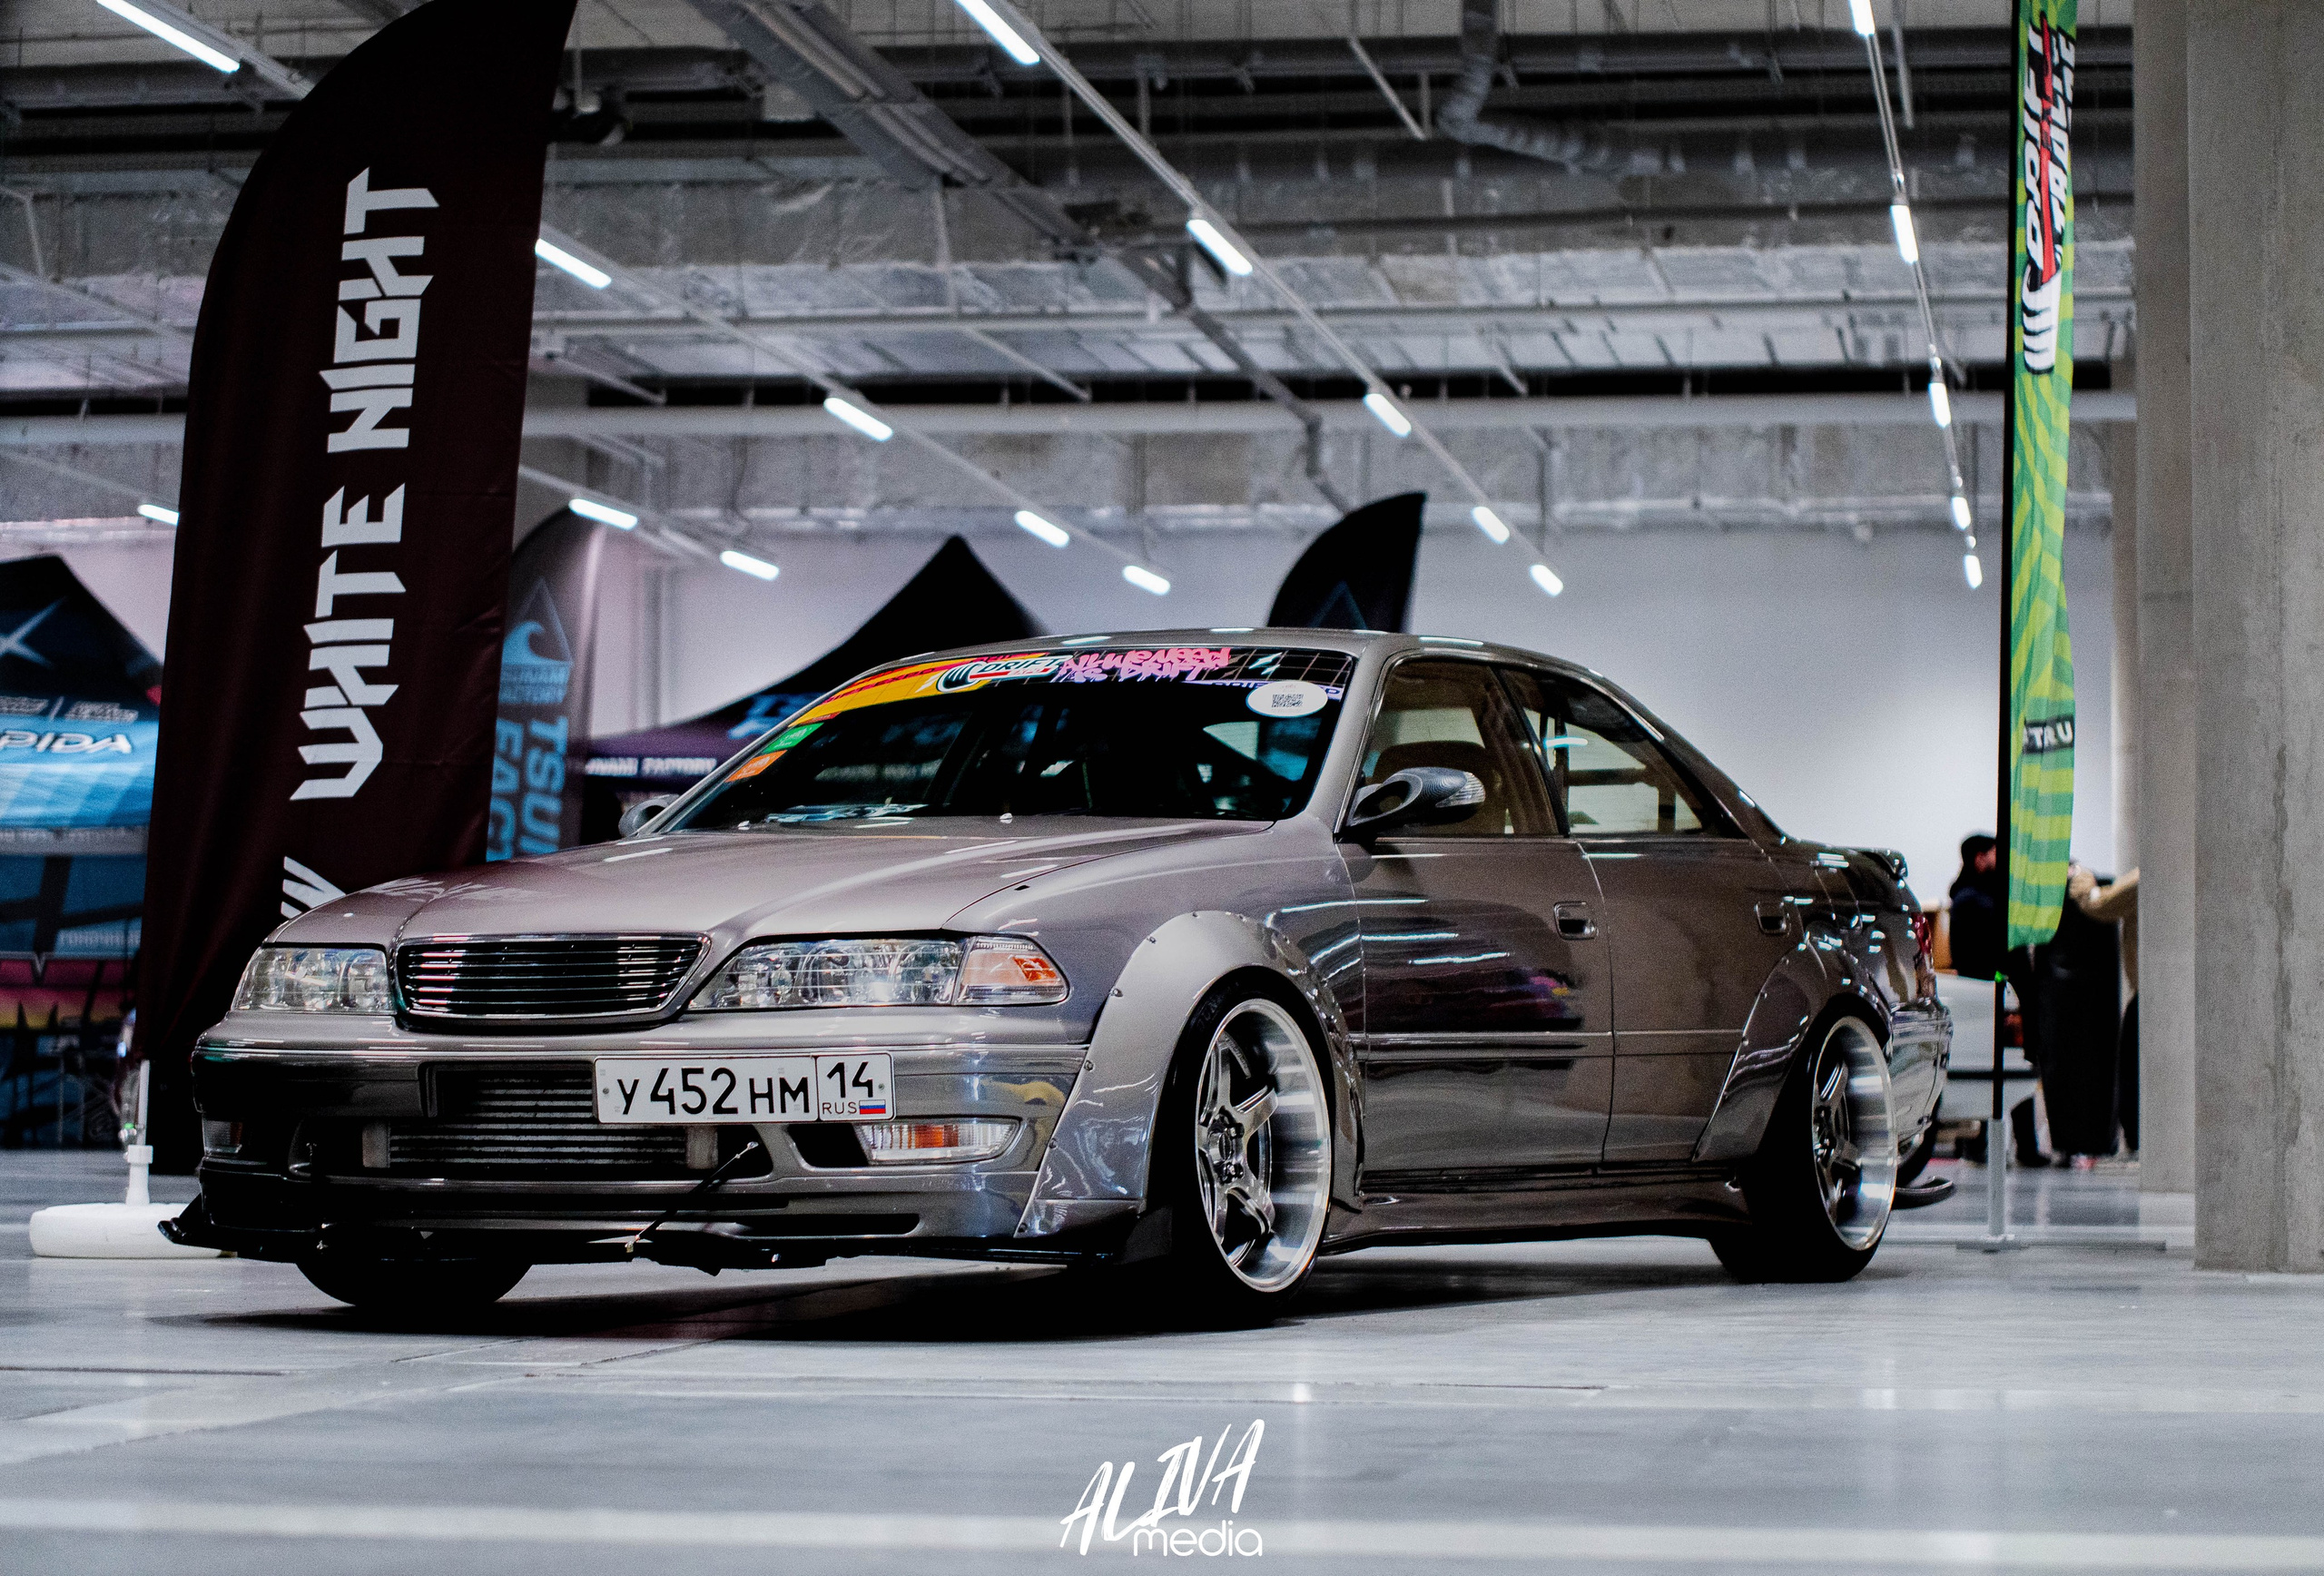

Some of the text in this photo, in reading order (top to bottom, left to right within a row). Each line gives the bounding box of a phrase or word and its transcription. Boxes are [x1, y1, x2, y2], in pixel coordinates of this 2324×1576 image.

[319, 166, 439, 453] NIGHT
[290, 482, 407, 801] WHITE
[977, 657, 1067, 673] DRIFT
[826, 1060, 874, 1098] 14
[822, 1101, 858, 1115] RUS
